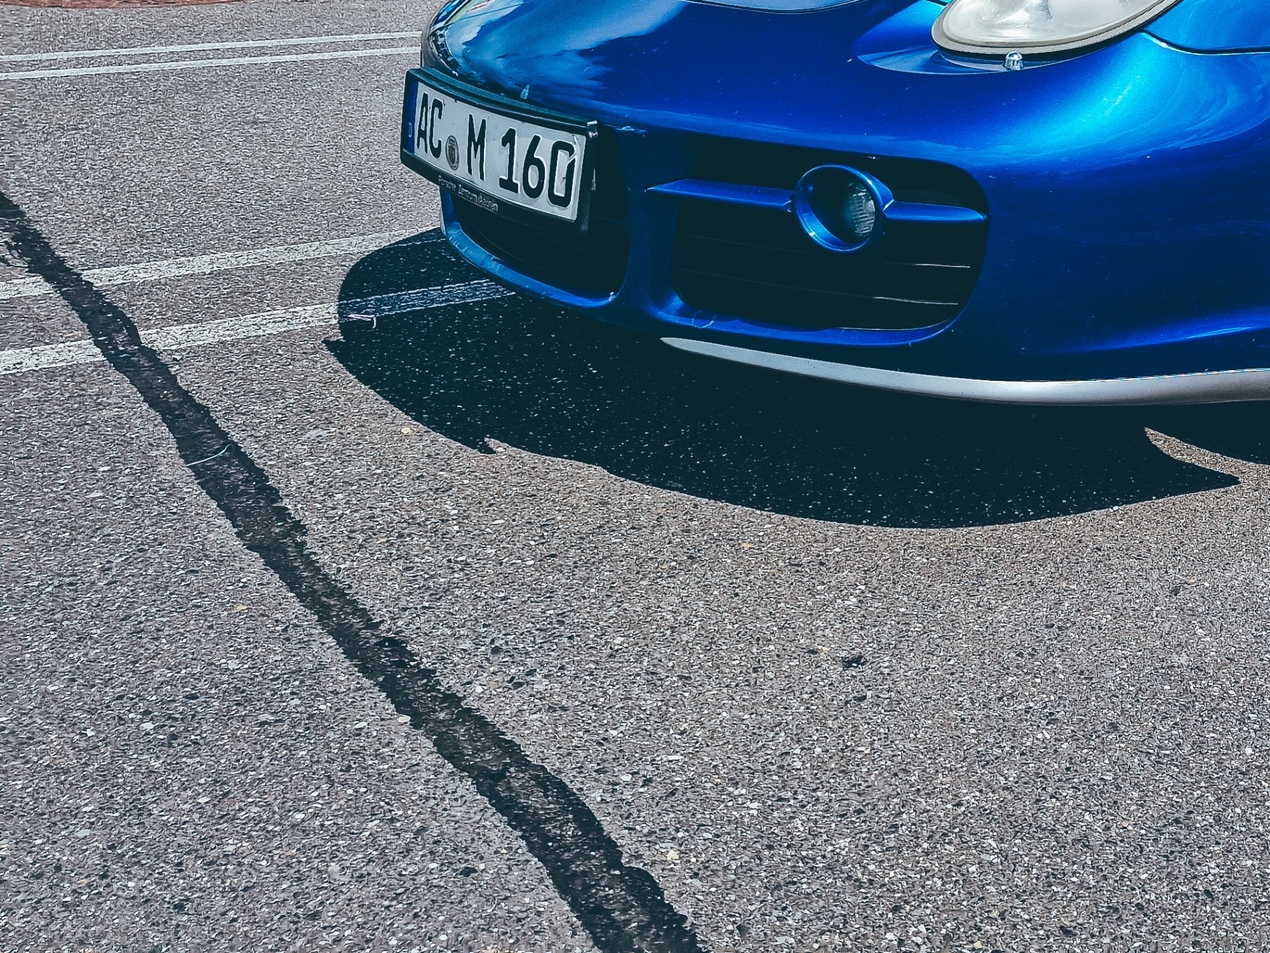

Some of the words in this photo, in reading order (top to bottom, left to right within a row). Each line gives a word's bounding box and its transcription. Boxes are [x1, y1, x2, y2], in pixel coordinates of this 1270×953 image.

[417, 92, 443, 159] AC
[467, 113, 486, 181] M
[499, 127, 577, 208] 160
